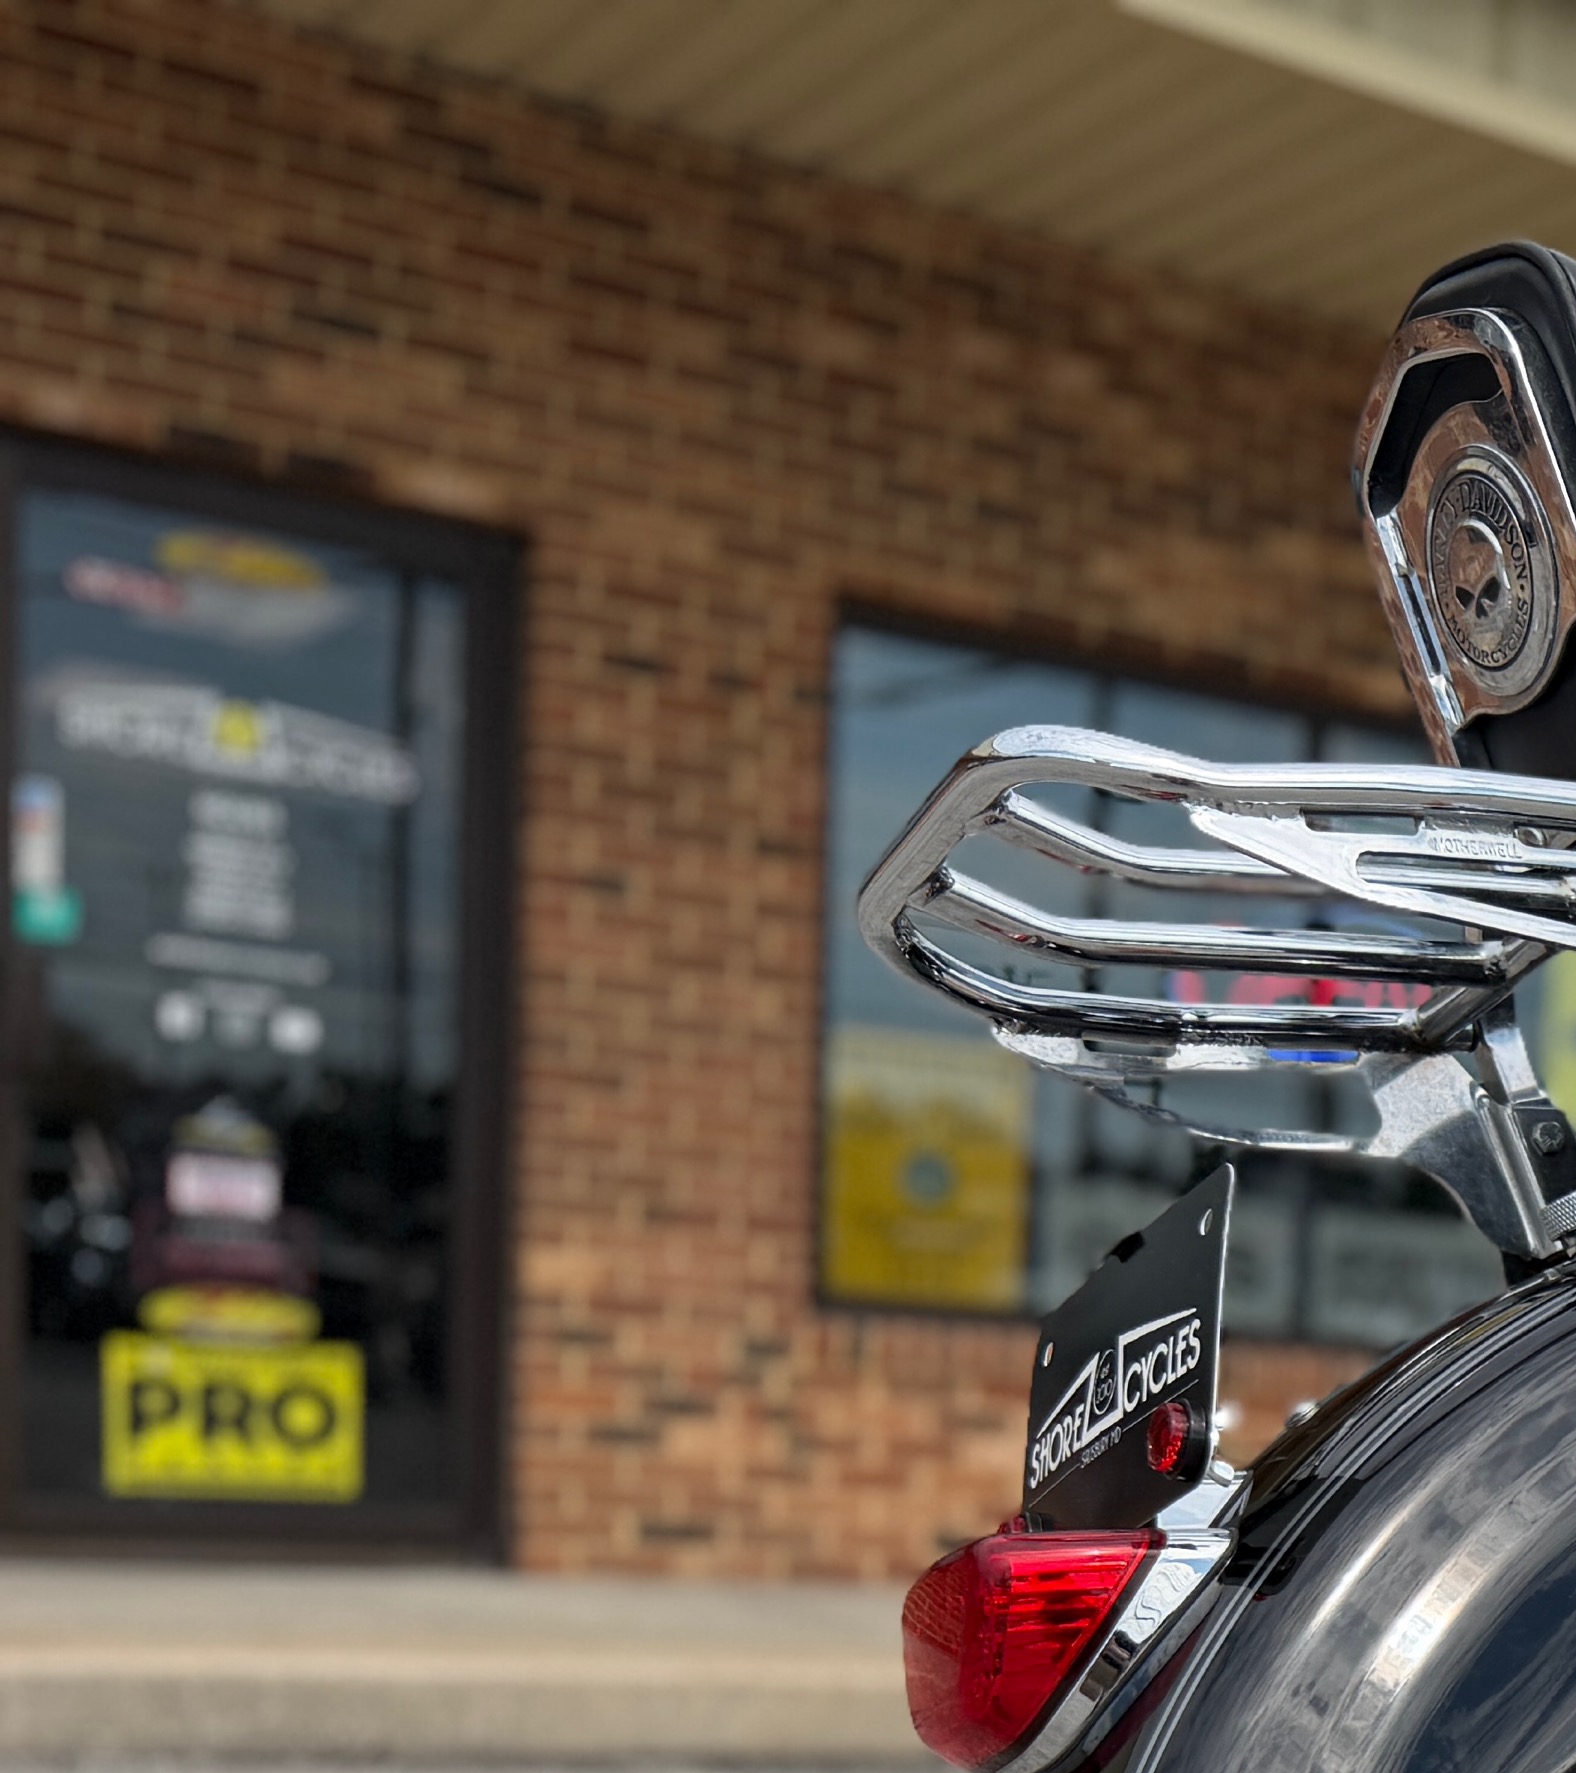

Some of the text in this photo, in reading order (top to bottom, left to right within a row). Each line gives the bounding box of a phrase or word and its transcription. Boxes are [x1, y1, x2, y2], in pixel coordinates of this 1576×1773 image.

[1447, 599, 1530, 665] MOTORCYCLES
[1429, 837, 1522, 859] MOTHERWELL
[128, 1376, 337, 1451] PRO
[1030, 1403, 1085, 1490] SHORE
[1124, 1318, 1201, 1413] CYCLES
